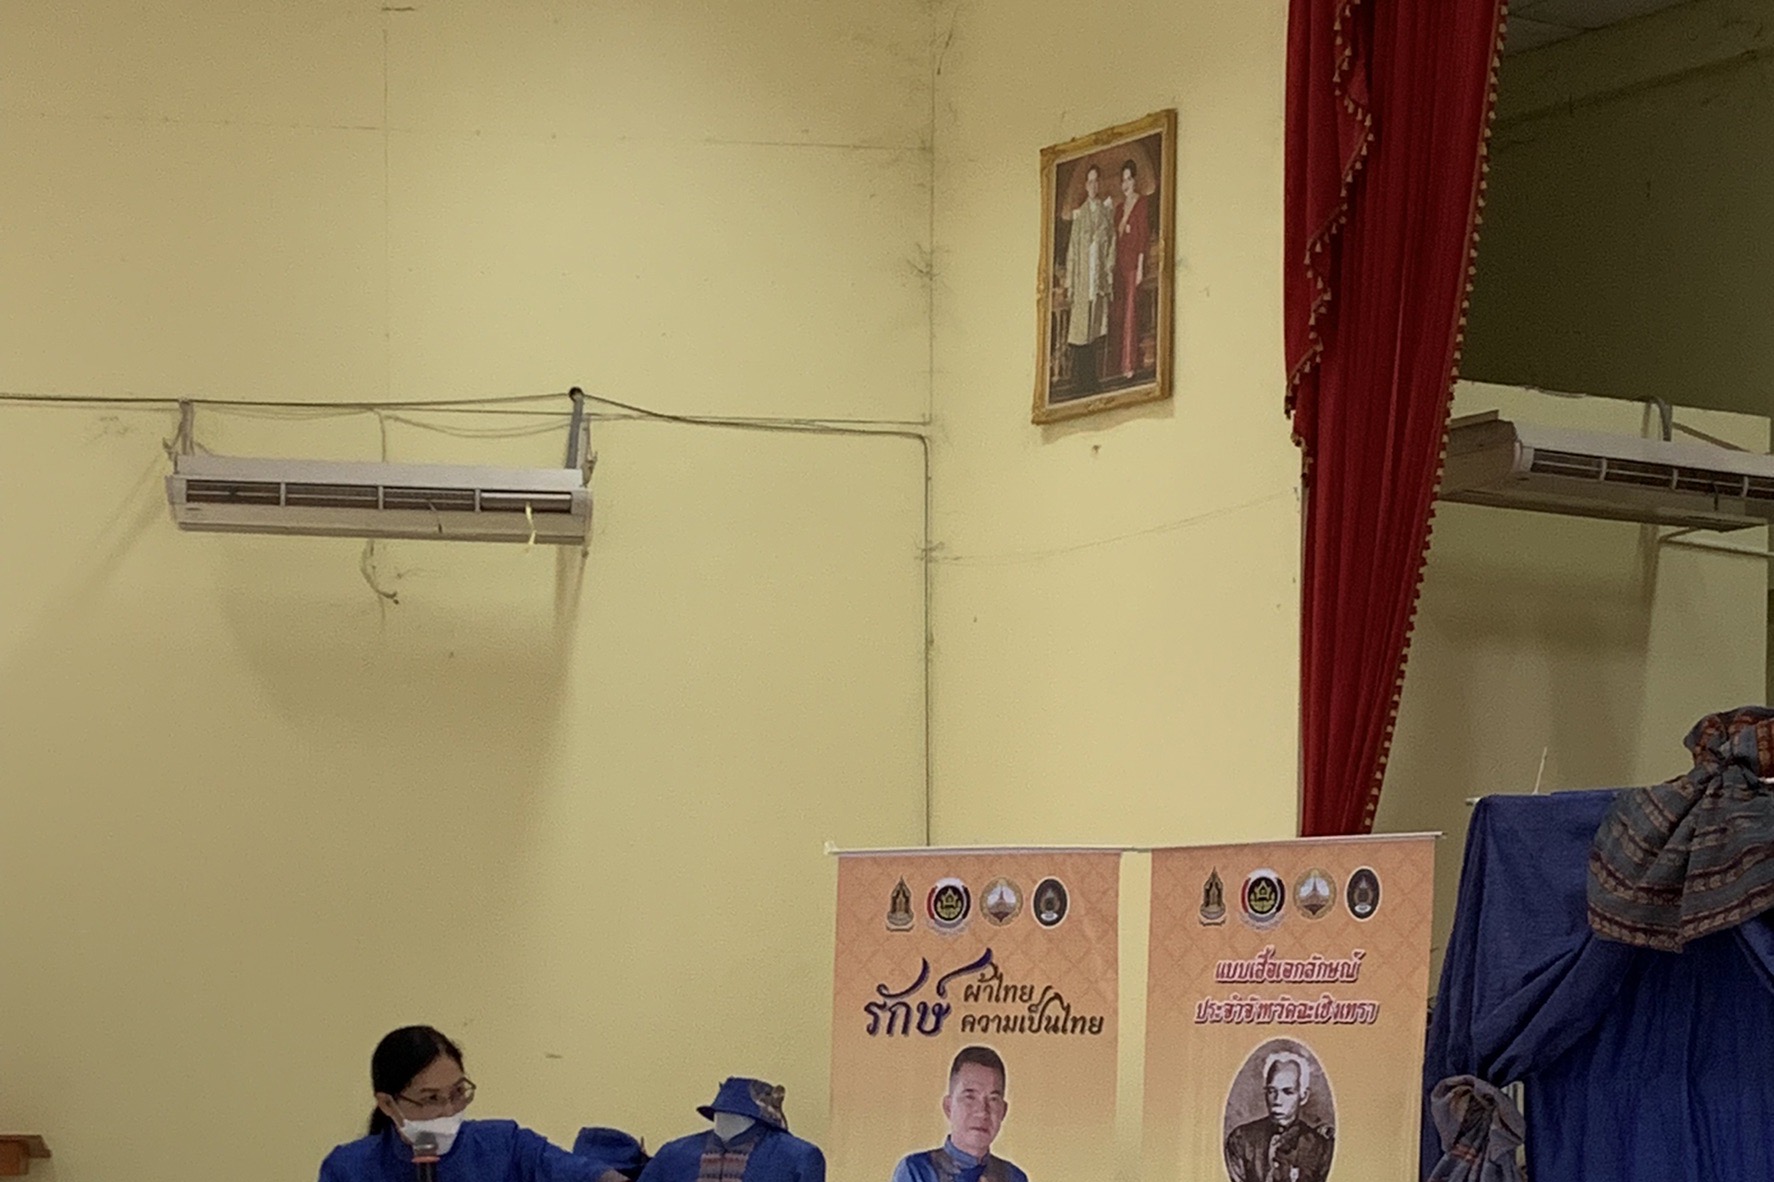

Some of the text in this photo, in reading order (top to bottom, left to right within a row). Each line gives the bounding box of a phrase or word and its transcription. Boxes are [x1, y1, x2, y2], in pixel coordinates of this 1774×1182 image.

[963, 961, 1035, 1004] ผ้าไทย
[1215, 946, 1367, 984] แบบเสื้อเอกลักษณ์
[863, 947, 993, 1036] รักษ์
[960, 985, 1105, 1036] ความเป็นไทย
[1194, 993, 1379, 1024] ประจำจังหวัดฉะเชิงเทรา
